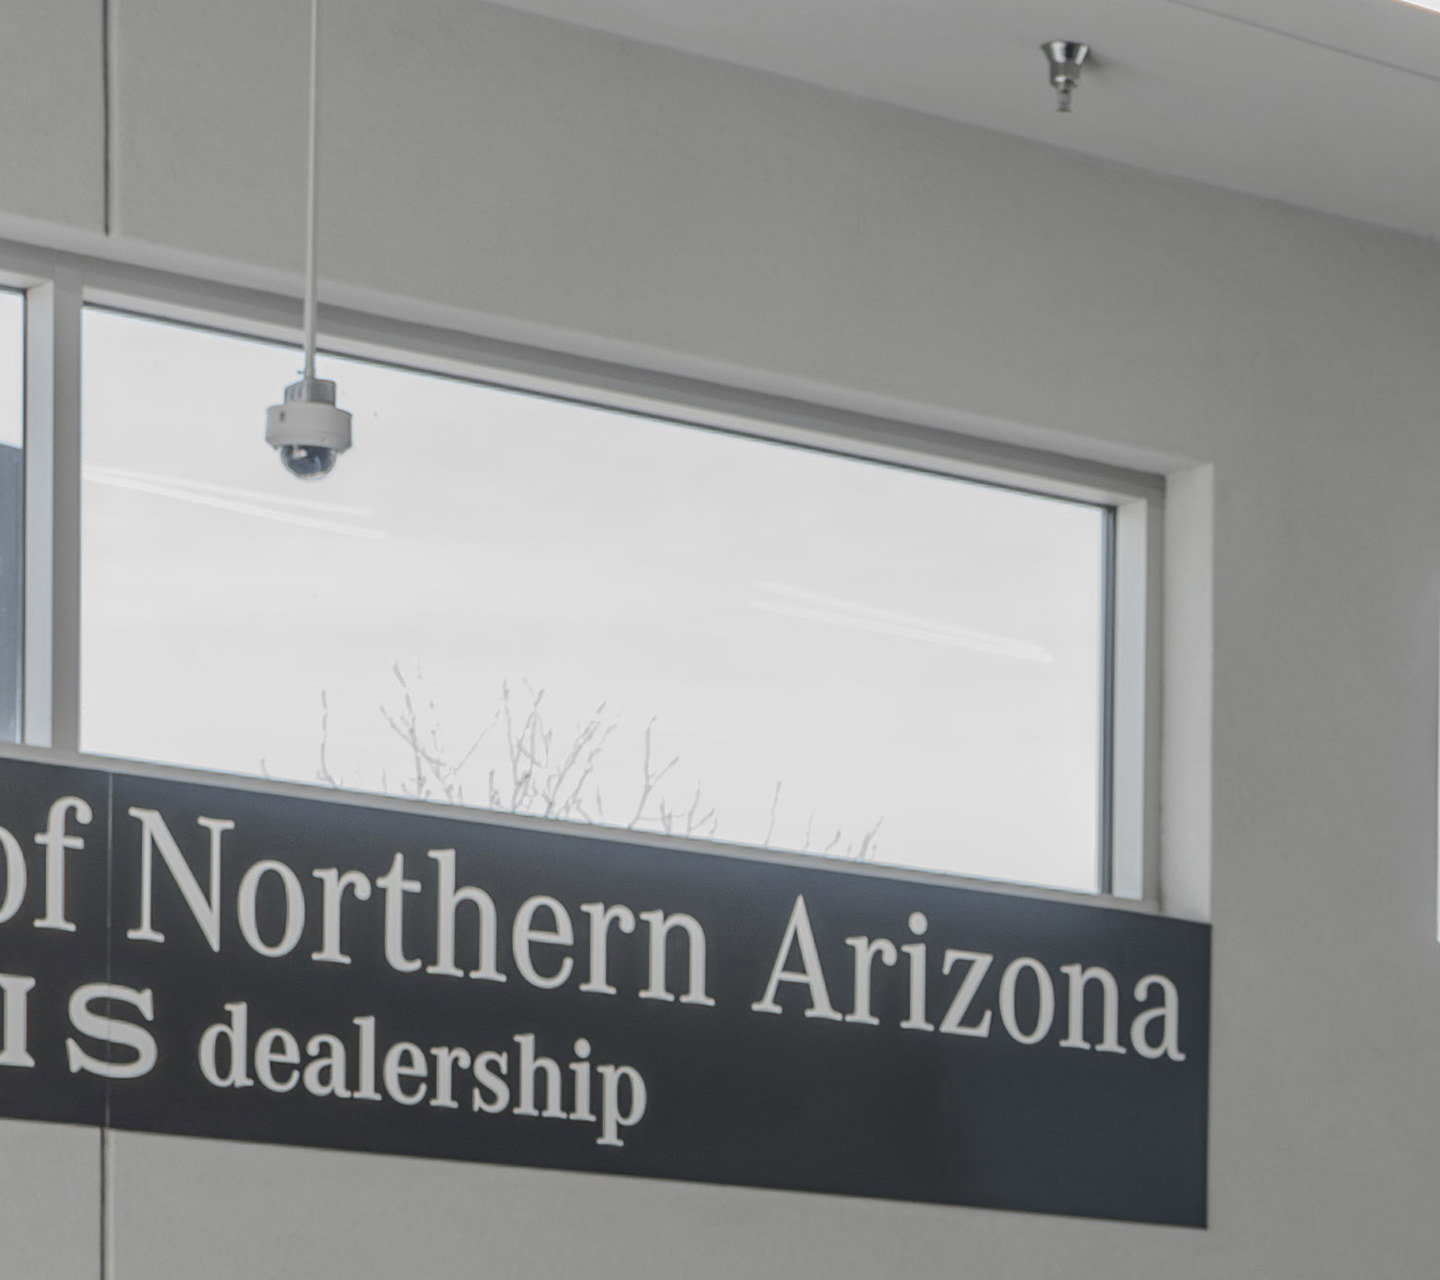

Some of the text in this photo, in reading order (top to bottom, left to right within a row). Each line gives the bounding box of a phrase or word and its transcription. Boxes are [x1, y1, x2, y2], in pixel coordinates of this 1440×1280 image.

[126, 806, 716, 1007] Northern
[751, 894, 1186, 1061] Arizona
[199, 1001, 647, 1147] dealership
